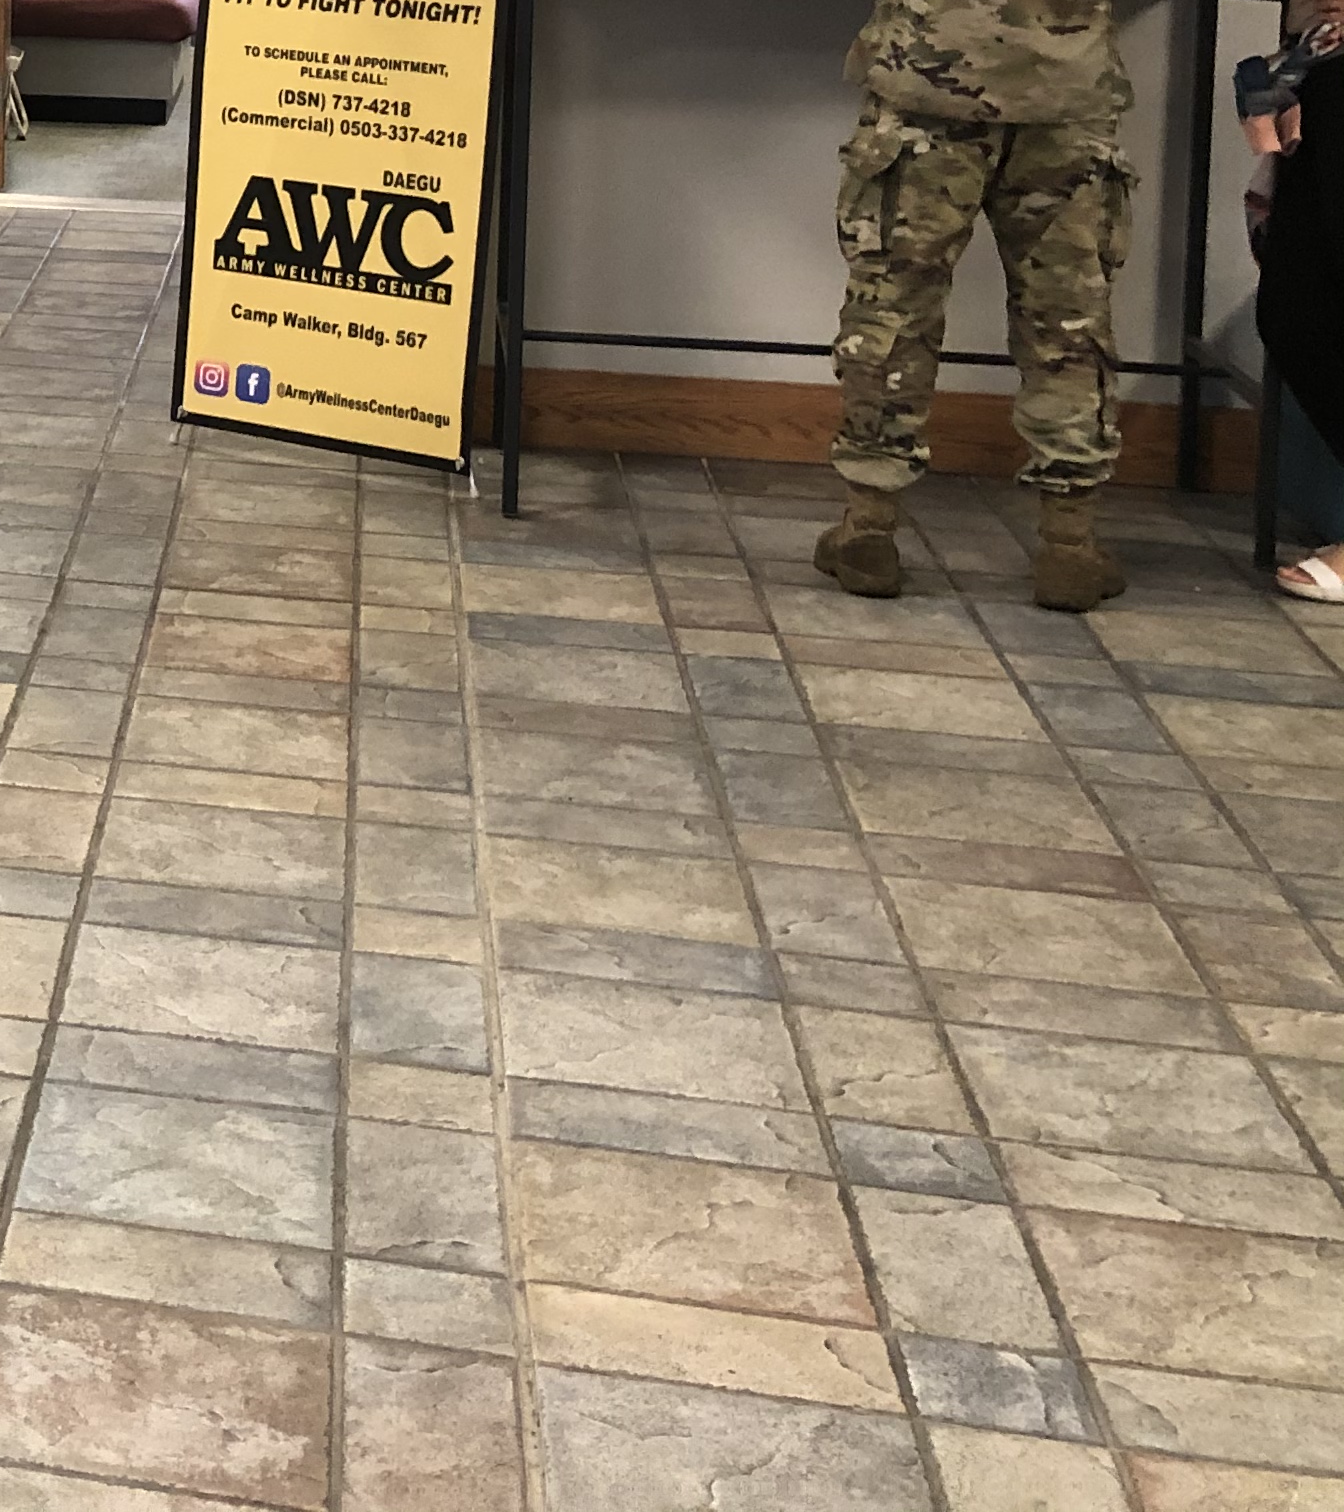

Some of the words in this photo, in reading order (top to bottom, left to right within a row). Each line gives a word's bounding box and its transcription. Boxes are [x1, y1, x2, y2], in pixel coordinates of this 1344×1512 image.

[244, 45, 260, 57] TO
[264, 47, 329, 65] SCHEDULE
[333, 54, 351, 66] AN
[354, 56, 449, 78] APPOINTMENT,
[300, 66, 348, 82] PLEASE
[352, 71, 388, 86] CALL:
[278, 89, 326, 112] (DSN)
[332, 94, 411, 118] 737-4218
[221, 106, 334, 137] (Commercial)
[340, 119, 468, 149] 0503-337-4218
[382, 170, 442, 193] DAEGU
[214, 175, 454, 282] AWC
[216, 255, 265, 274] ARMY
[274, 262, 367, 290] WELLNESS
[376, 278, 447, 302] CENTER
[231, 303, 278, 328] Camp
[283, 311, 342, 339] Walker,
[347, 322, 390, 347] Bldg.
[395, 330, 428, 349] 567
